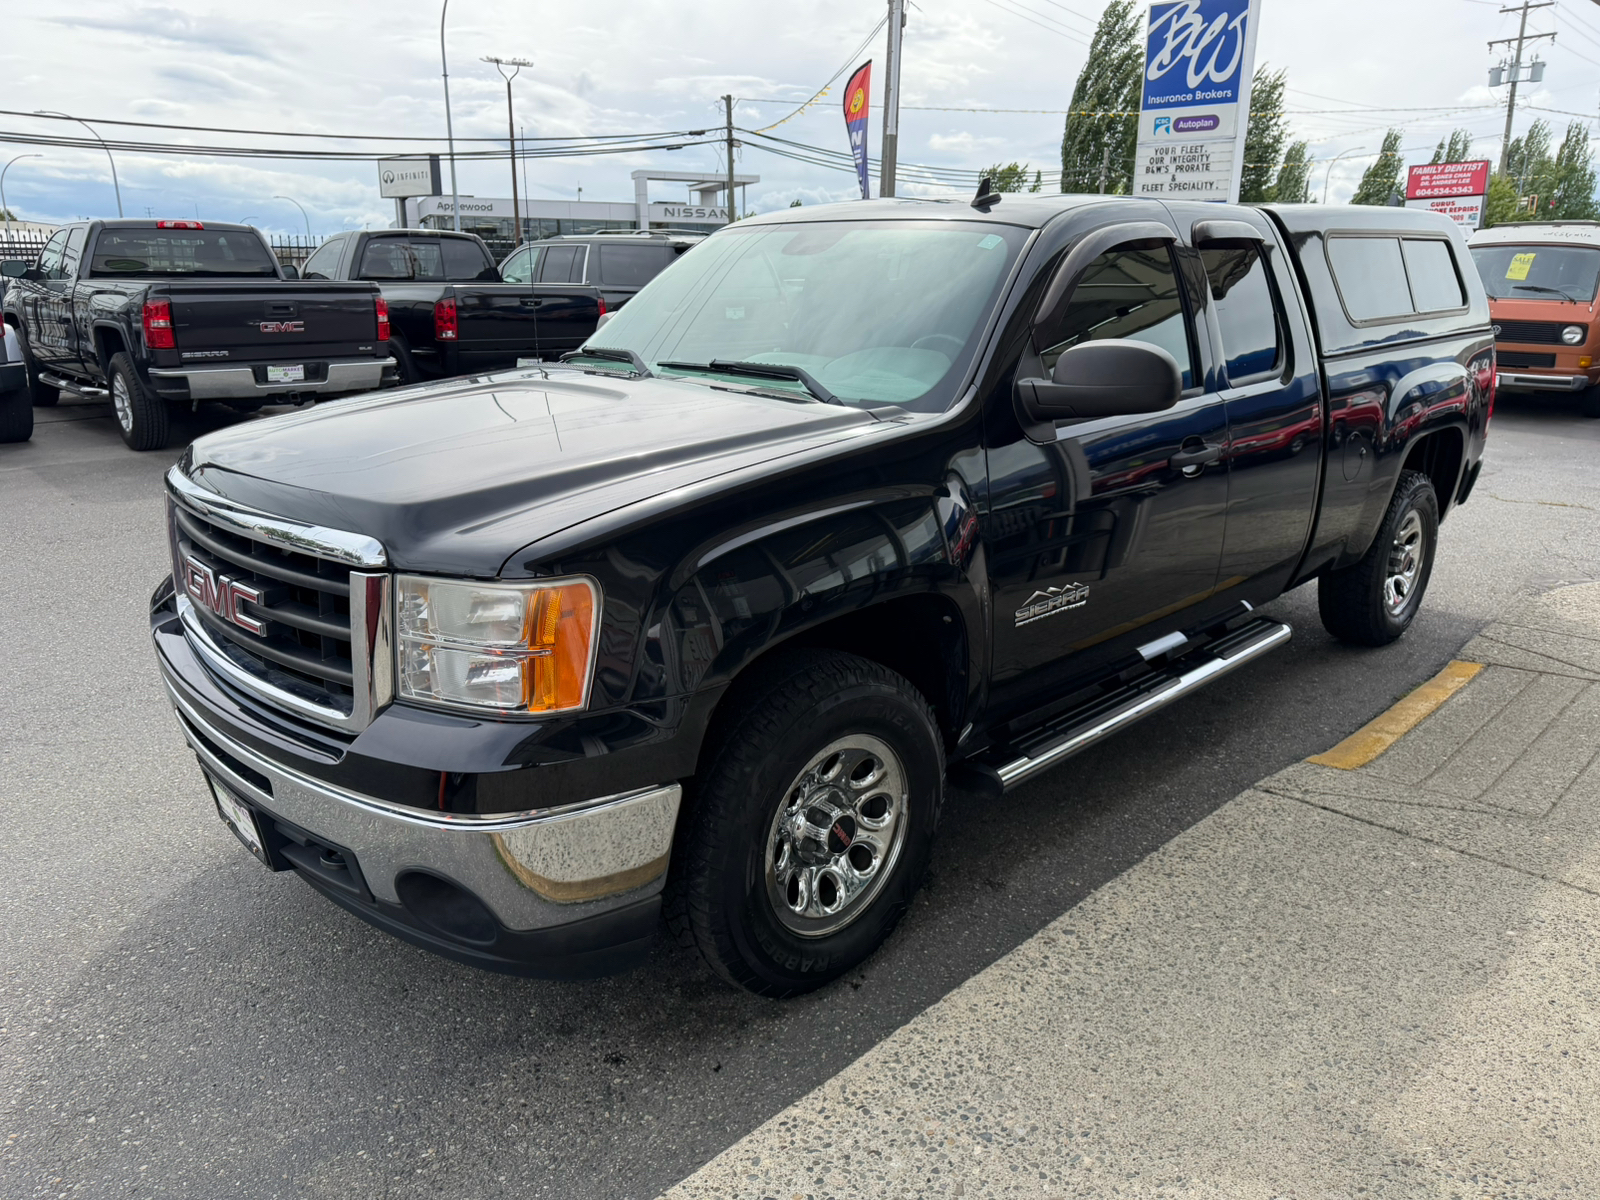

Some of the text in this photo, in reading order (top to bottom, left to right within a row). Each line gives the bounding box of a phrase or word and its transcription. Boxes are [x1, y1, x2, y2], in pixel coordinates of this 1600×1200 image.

[1148, 89, 1232, 104] Insurance Brokers
[1178, 119, 1213, 129] Autoplan
[1154, 145, 1208, 156] YOUR FLEET.
[1149, 154, 1211, 165] OUR INTEGRITY
[1145, 163, 1211, 174] B&W'S PRORATE
[1412, 162, 1484, 175] FAMILY DENTIST
[397, 171, 428, 181] INFINITI
[1171, 174, 1176, 182] &
[1142, 181, 1219, 192] FLEET SPECIALITY.
[437, 202, 493, 212] Appewood
[664, 207, 730, 219] NISSAN
[260, 321, 305, 332] GMC
[182, 350, 229, 358] SIERRA
[186, 555, 267, 637] GMC
[1014, 585, 1090, 623] SIERRA
